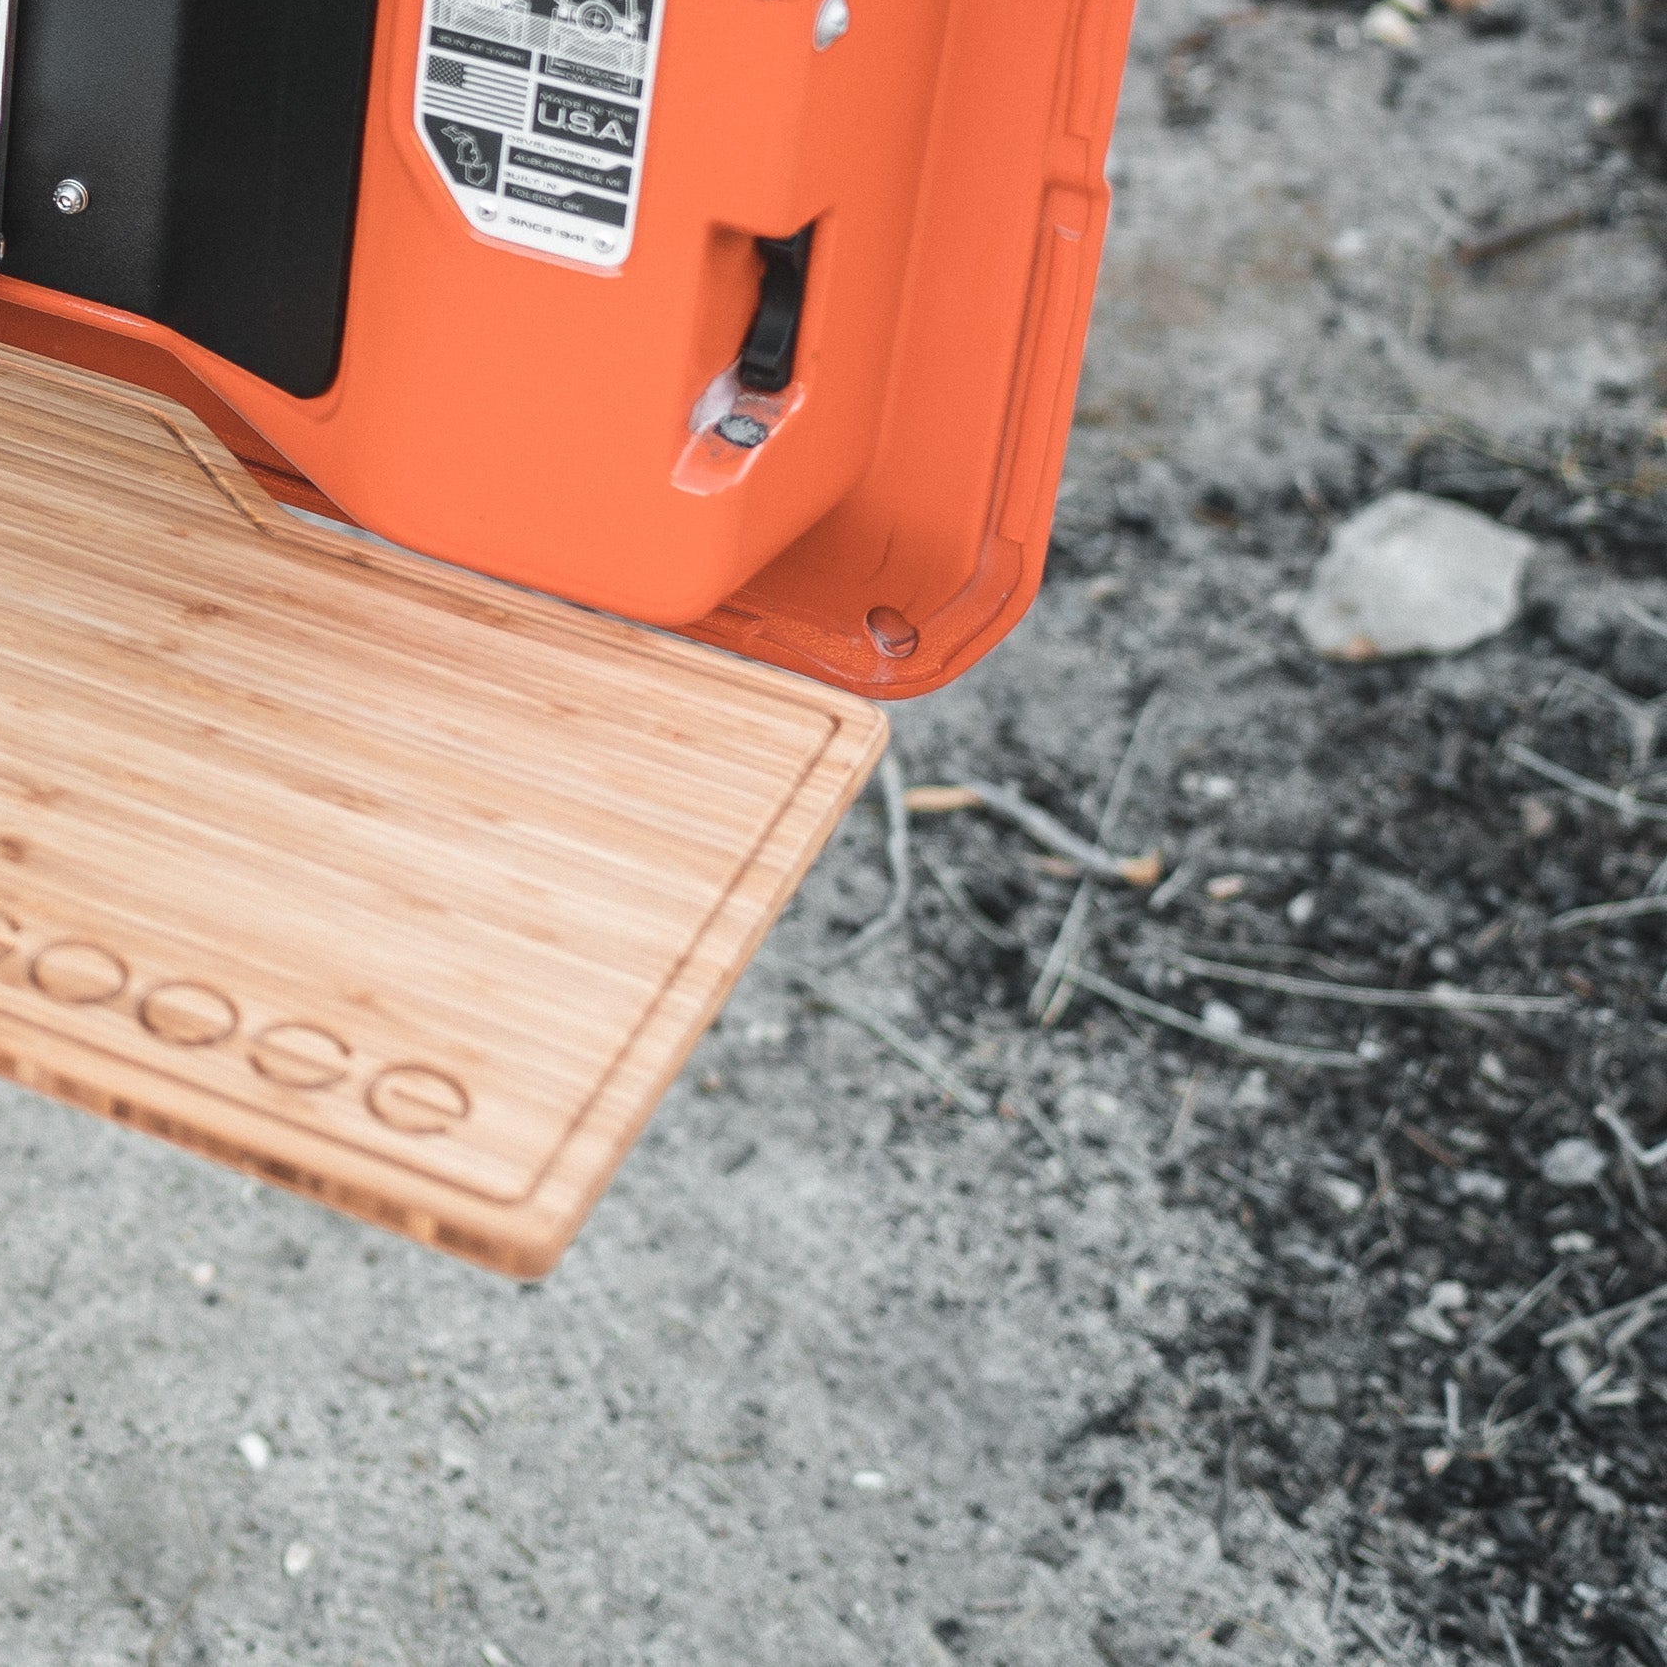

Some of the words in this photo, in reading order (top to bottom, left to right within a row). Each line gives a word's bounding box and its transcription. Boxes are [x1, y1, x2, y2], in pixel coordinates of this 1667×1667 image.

[468, 41, 483, 52] AT
[538, 92, 580, 109] MADE
[585, 104, 600, 115] IN
[605, 108, 633, 123] THE
[536, 101, 633, 147] U.S.A.
[506, 134, 584, 160] DEVELOPED
[586, 155, 601, 164] IN
[513, 153, 564, 173] AUBURN
[503, 170, 537, 184] BUILT
[542, 180, 557, 190] IN
[507, 215, 552, 234] SINCE
[555, 228, 584, 243] 1941
